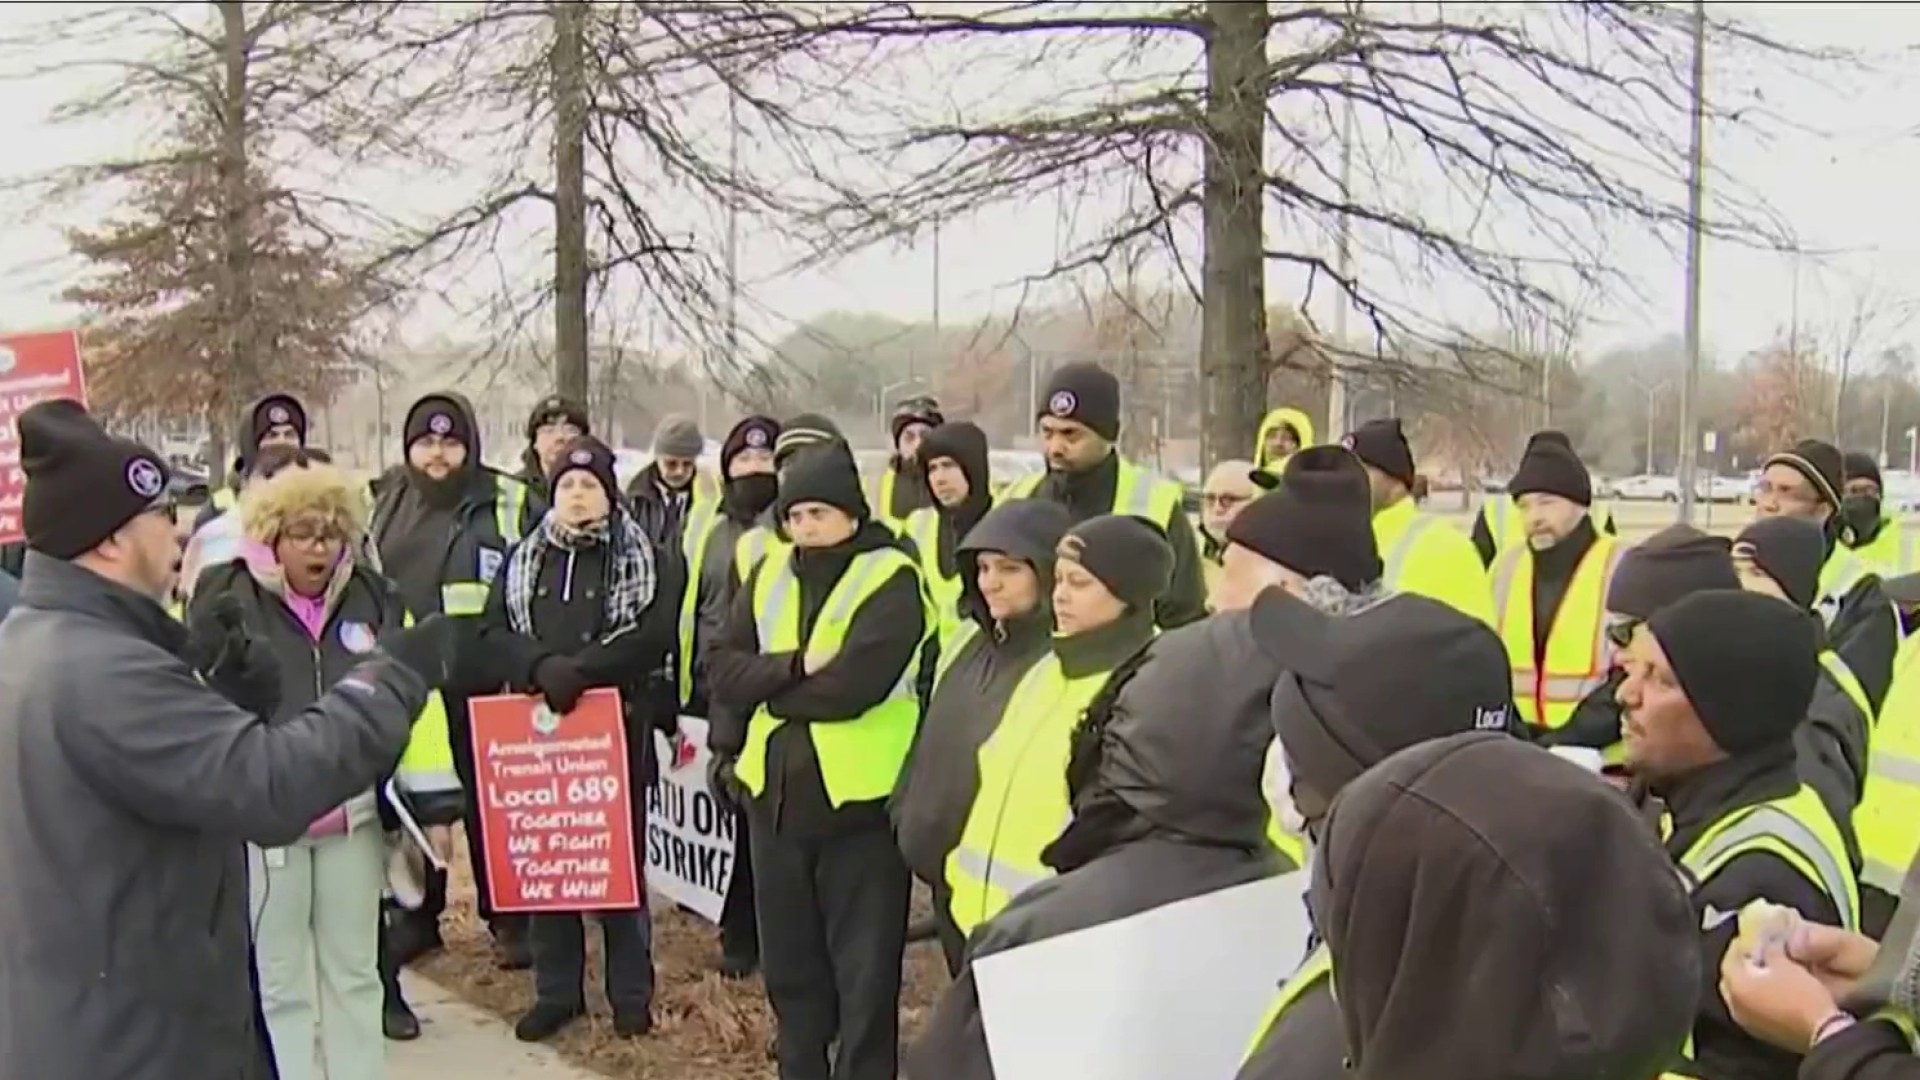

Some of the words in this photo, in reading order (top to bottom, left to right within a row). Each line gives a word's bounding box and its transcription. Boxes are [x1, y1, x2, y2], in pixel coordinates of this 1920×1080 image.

[1475, 703, 1507, 728] Local
[491, 759, 553, 778] Transit
[555, 754, 608, 774] Union
[489, 777, 559, 808] Local
[567, 776, 619, 803] 689
[650, 778, 685, 828] ATU
[693, 790, 734, 841] ON
[650, 823, 731, 897] STRIKE
